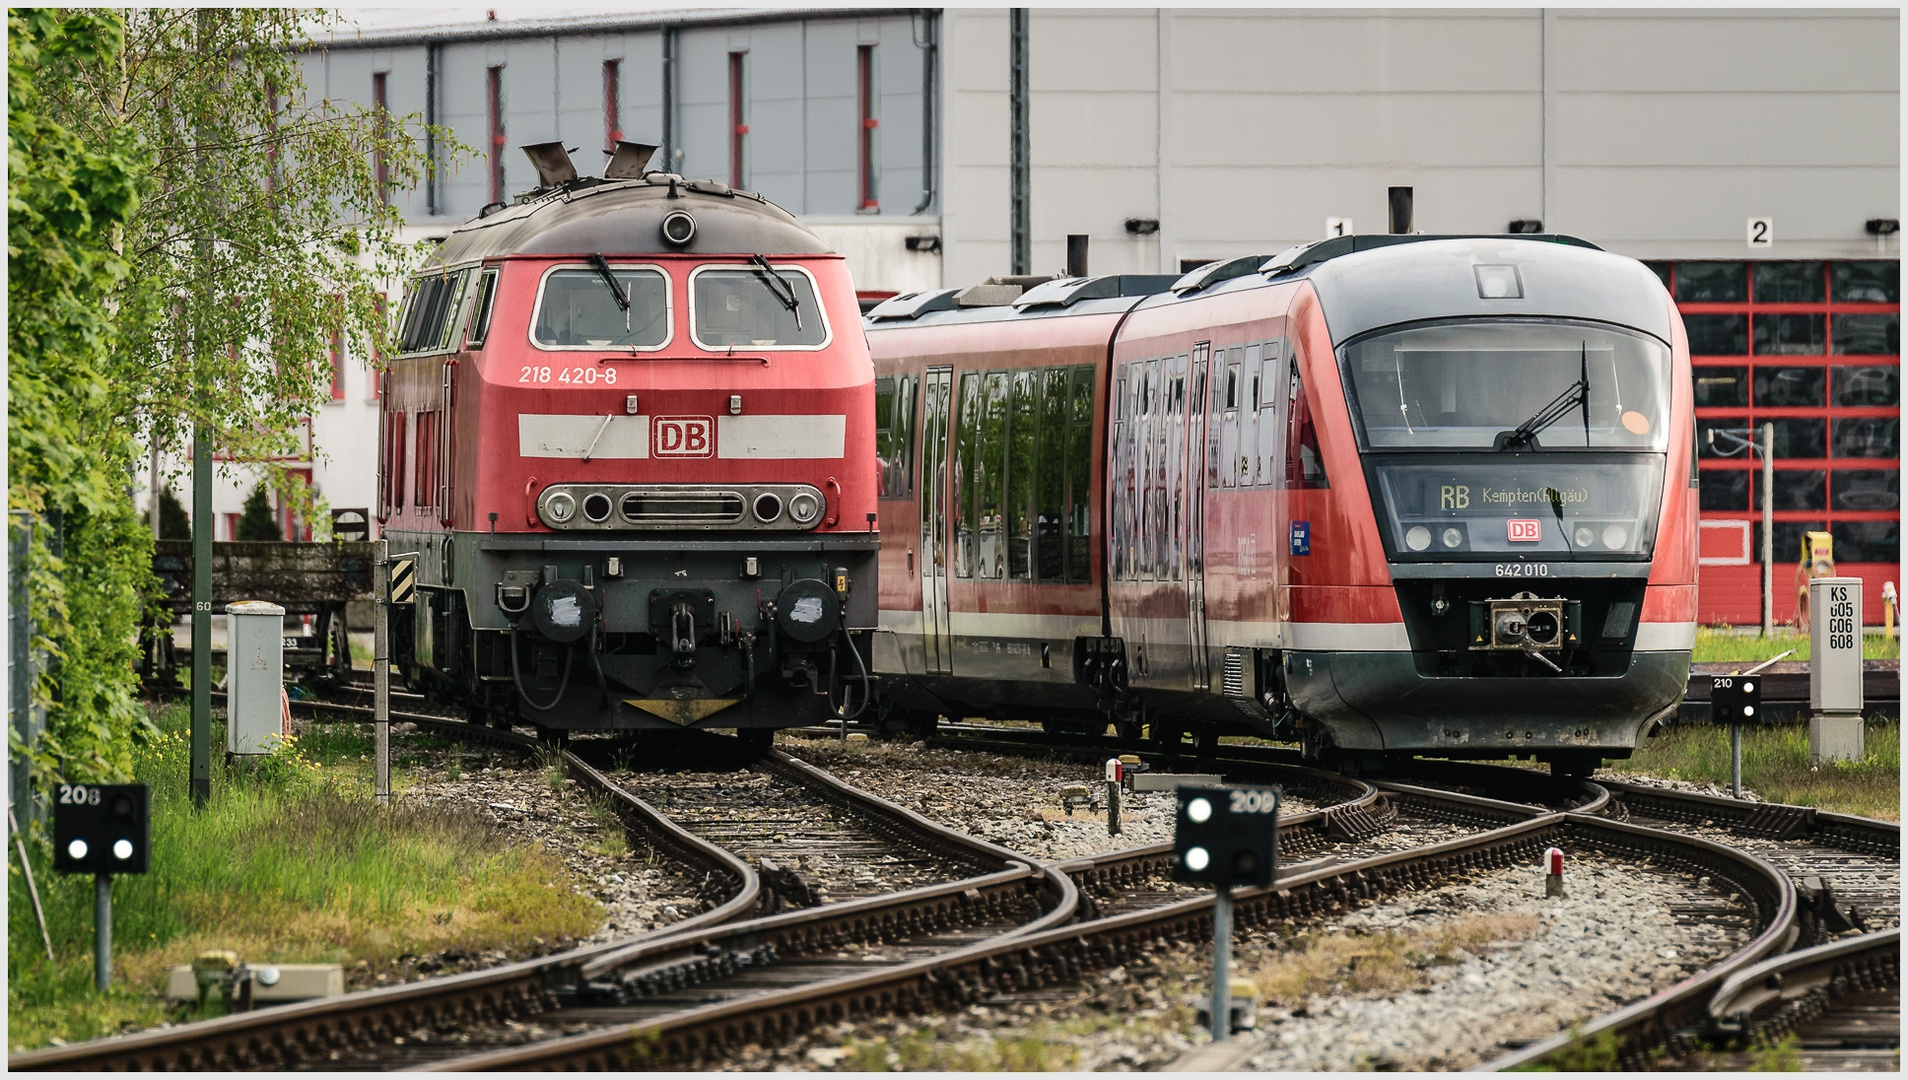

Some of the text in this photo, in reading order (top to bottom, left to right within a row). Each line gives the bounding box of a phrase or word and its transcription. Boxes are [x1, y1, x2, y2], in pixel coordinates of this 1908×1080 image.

[1753, 221, 1768, 243] 2
[519, 366, 617, 384] 218 420-8
[661, 423, 707, 450] DB
[1440, 485, 1588, 509] RB Kempten(Allgäu)
[1512, 523, 1537, 537] DB
[1495, 563, 1548, 577] 642 010
[1831, 587, 1847, 601] KS
[196, 601, 211, 611] 60
[1829, 634, 1853, 649] 608
[1714, 678, 1733, 688] 210
[59, 784, 101, 806] 208
[1229, 790, 1275, 814] 209
